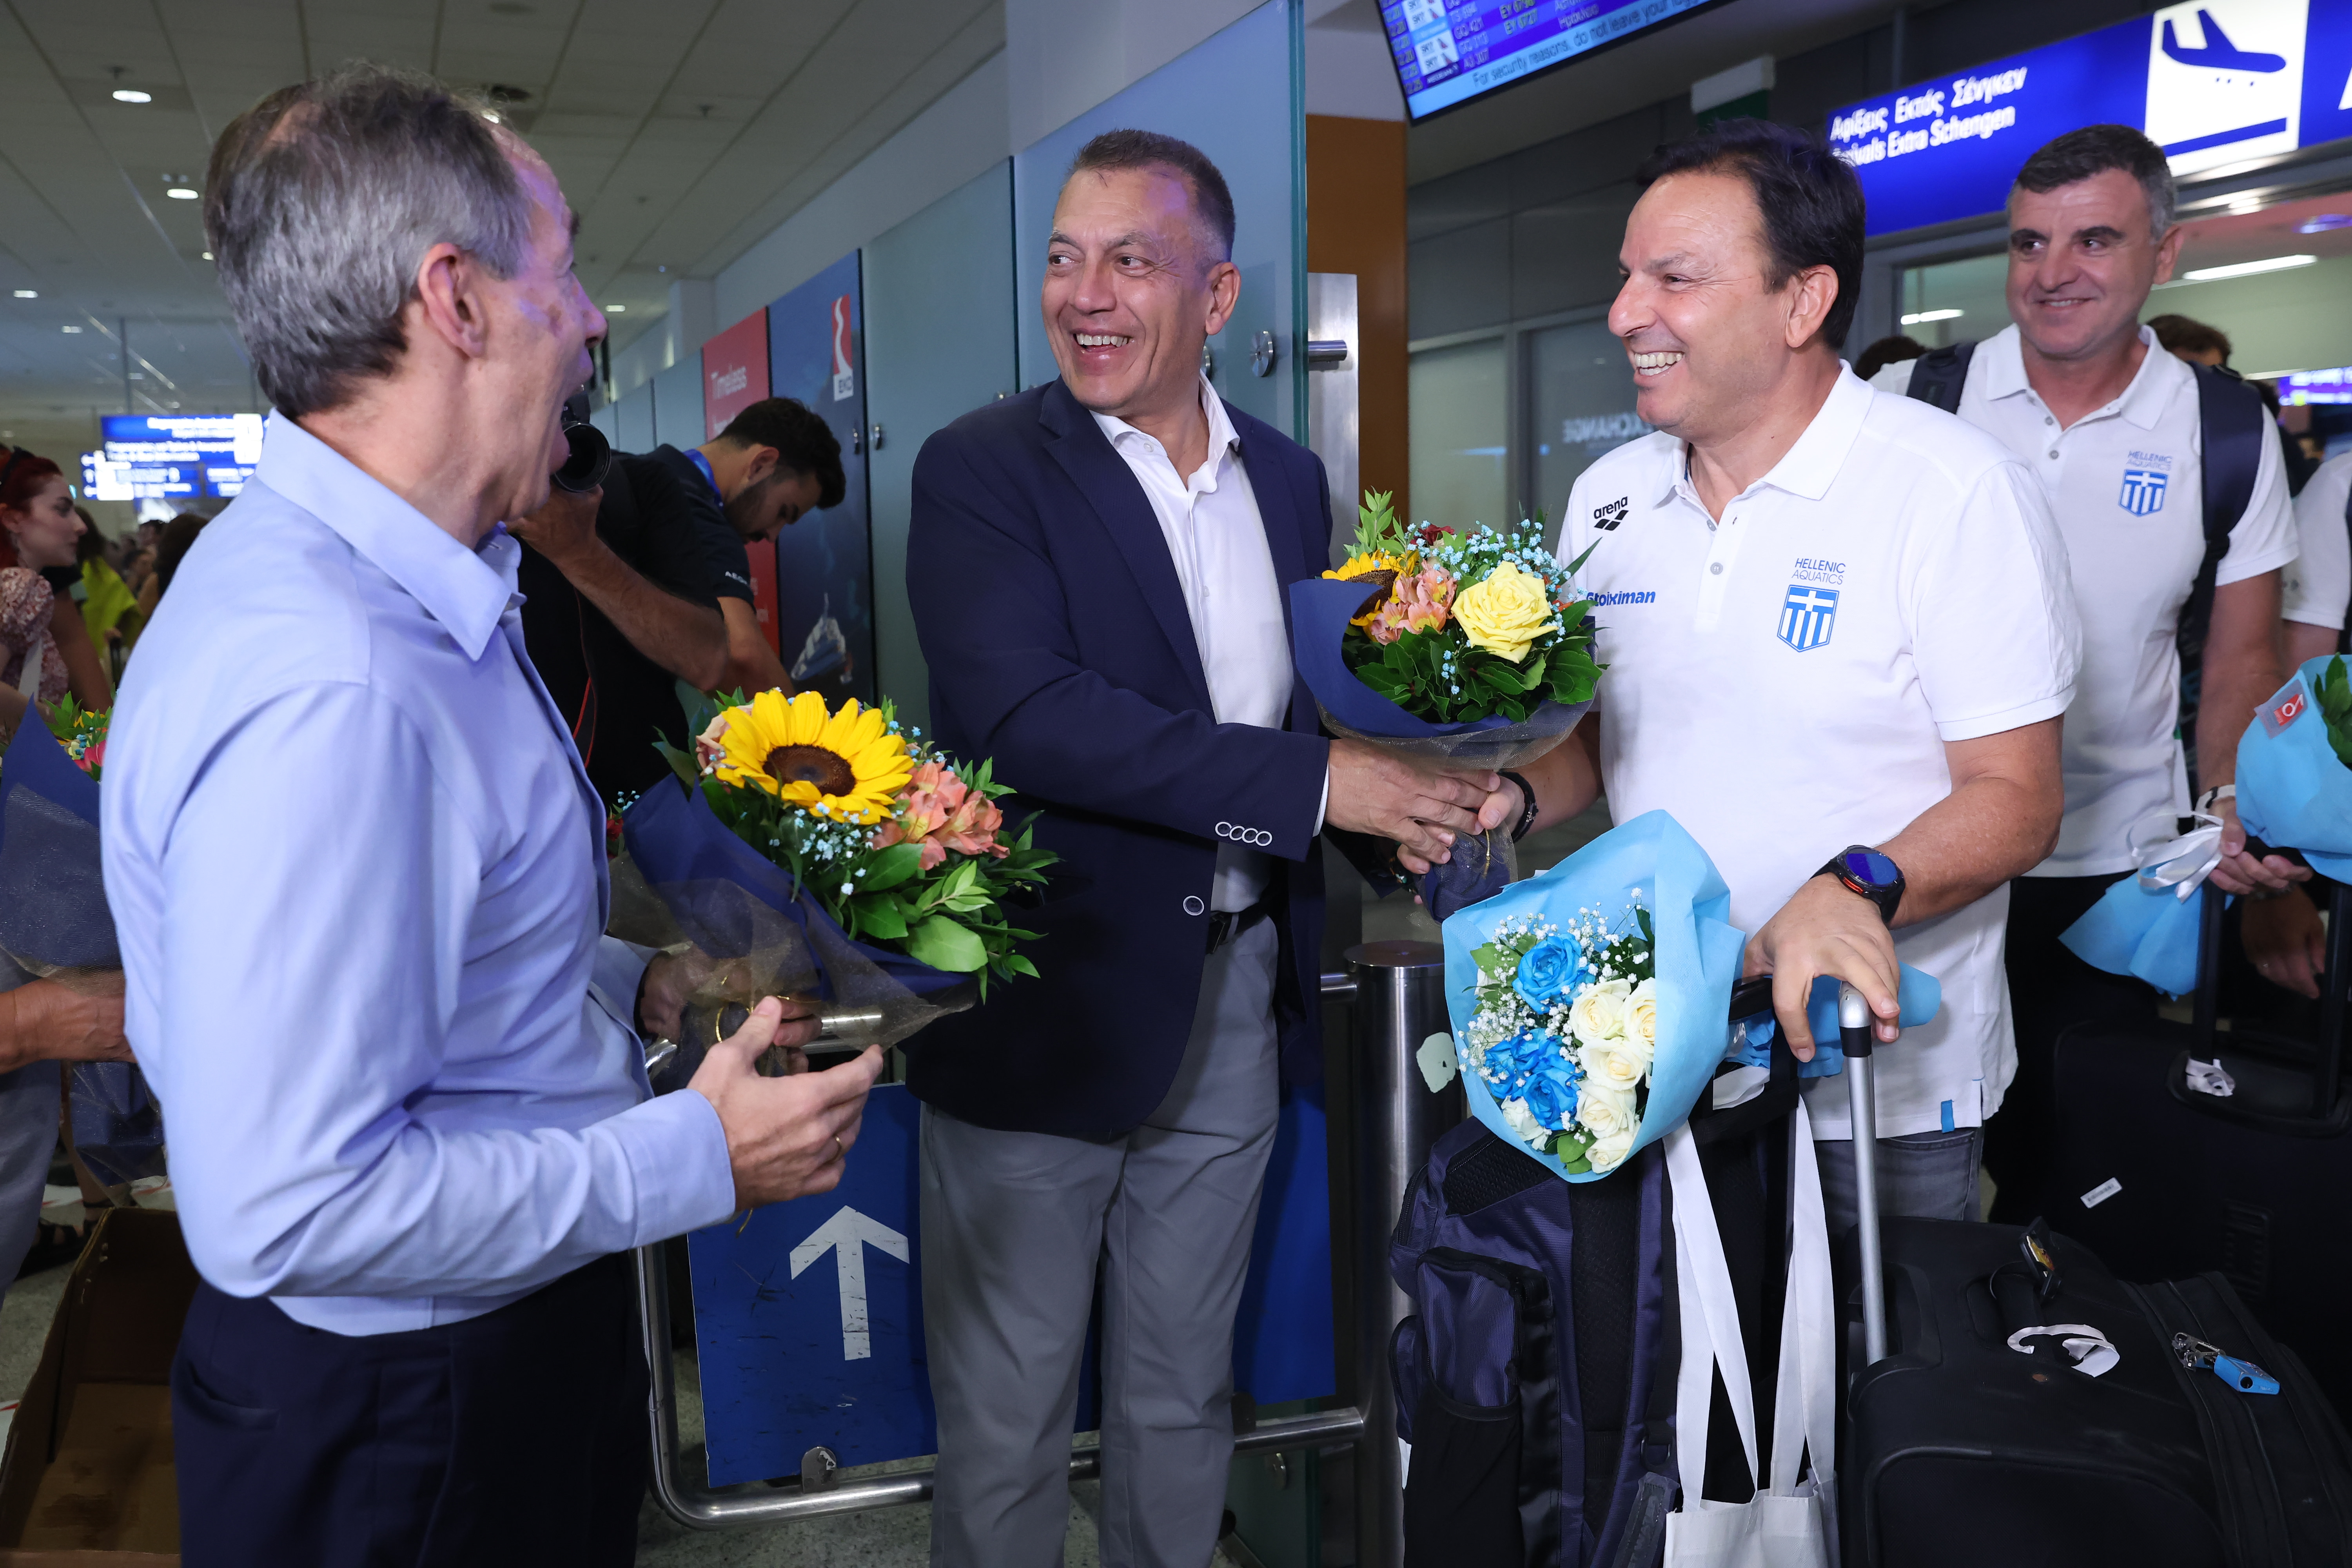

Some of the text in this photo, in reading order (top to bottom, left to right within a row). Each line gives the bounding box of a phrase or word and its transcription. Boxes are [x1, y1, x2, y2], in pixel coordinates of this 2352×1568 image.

[1490, 57, 1528, 79] security
[1573, 31, 1588, 47] do
[1589, 21, 1608, 41] not
[1609, 10, 1641, 31] leave
[1887, 129, 1929, 158] Extra
[1929, 106, 2016, 146] Schengen
[2127, 450, 2173, 464] HELLENIC
[1593, 496, 1628, 519] arena
[1795, 558, 1846, 573] HELLENIC
[1791, 570, 1843, 584] AQUATICS
